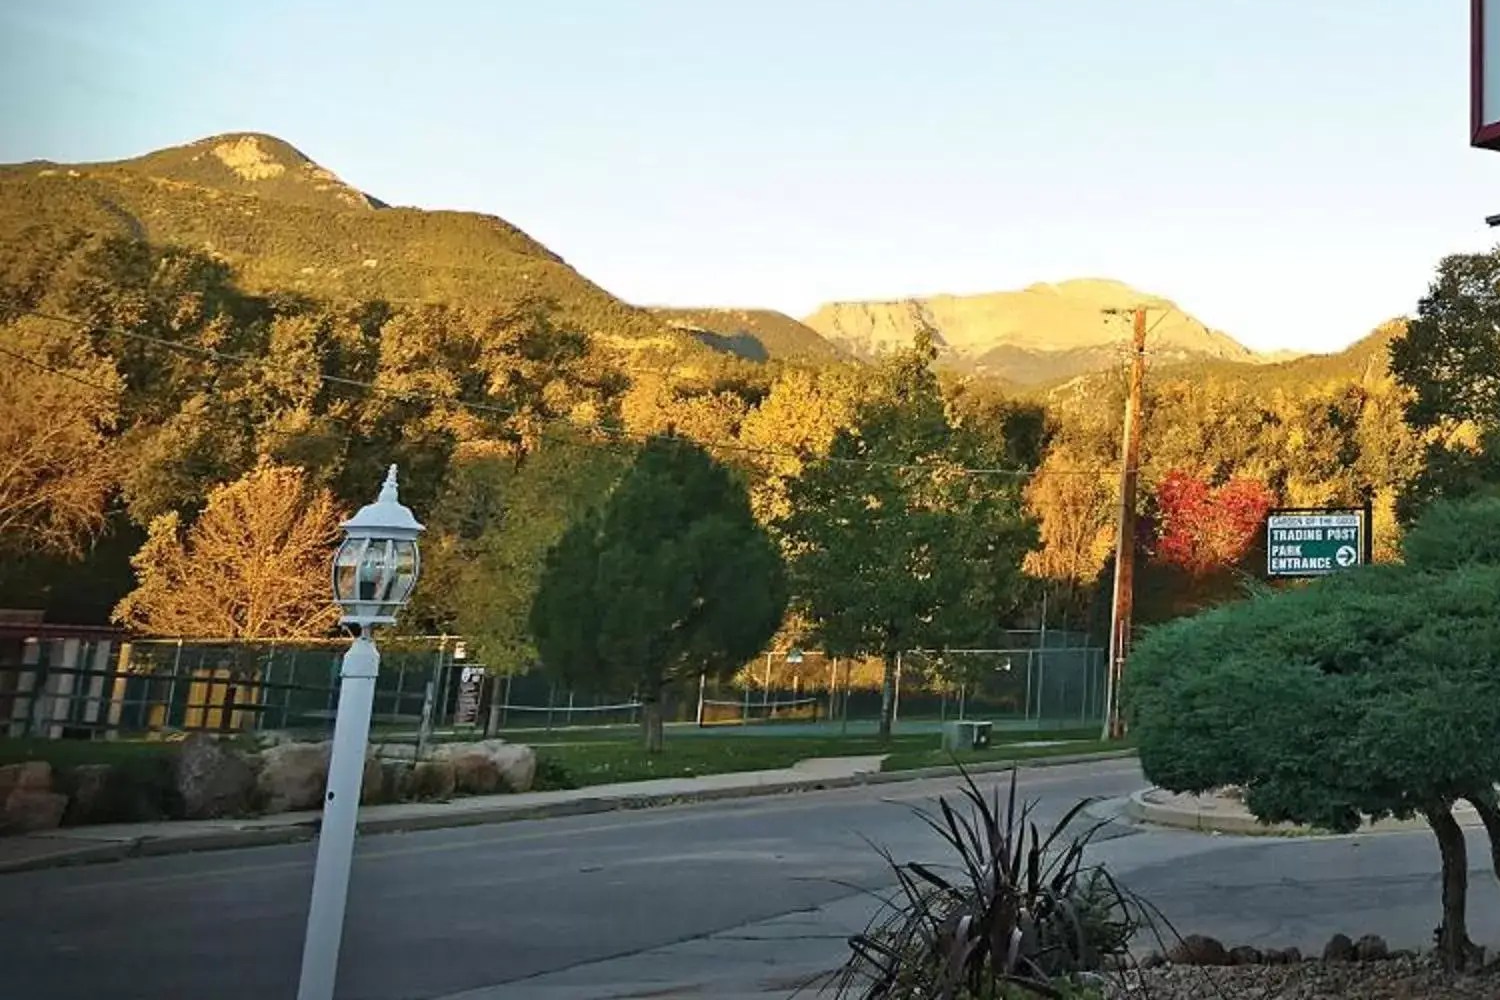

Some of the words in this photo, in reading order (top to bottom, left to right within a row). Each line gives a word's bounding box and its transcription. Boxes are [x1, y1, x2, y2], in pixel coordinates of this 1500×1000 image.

[1272, 528, 1323, 540] TRADING
[1327, 528, 1356, 540] POST
[1271, 545, 1302, 557] PARK
[1271, 557, 1332, 569] ENTRANCE
